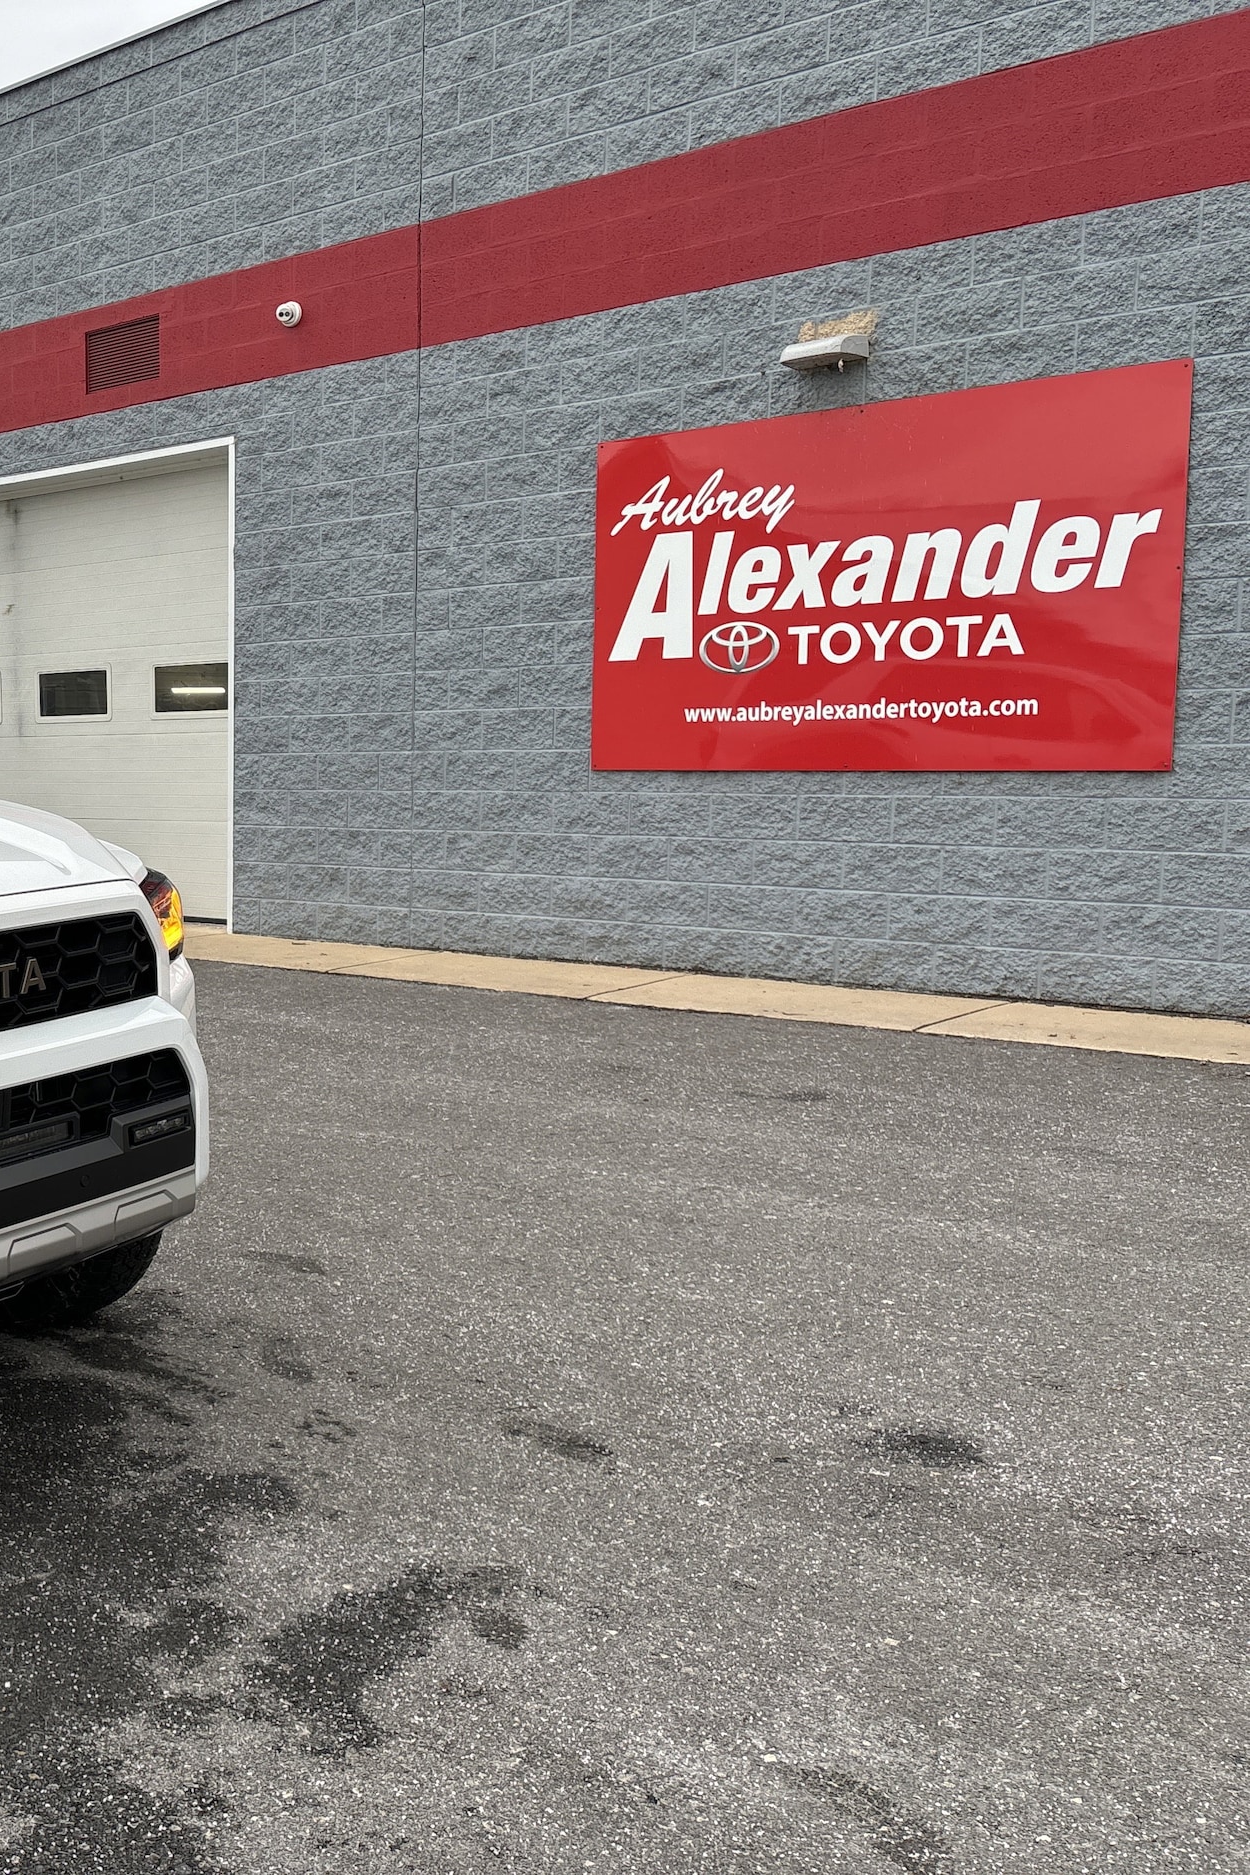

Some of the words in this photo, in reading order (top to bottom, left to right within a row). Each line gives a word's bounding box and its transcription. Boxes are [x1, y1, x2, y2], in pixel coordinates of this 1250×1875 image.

[611, 468, 795, 537] Aubrey
[608, 499, 1163, 662] Alexander
[787, 613, 1025, 665] TOYOTA
[684, 697, 1039, 726] www.aubreyalexandertoyota.com
